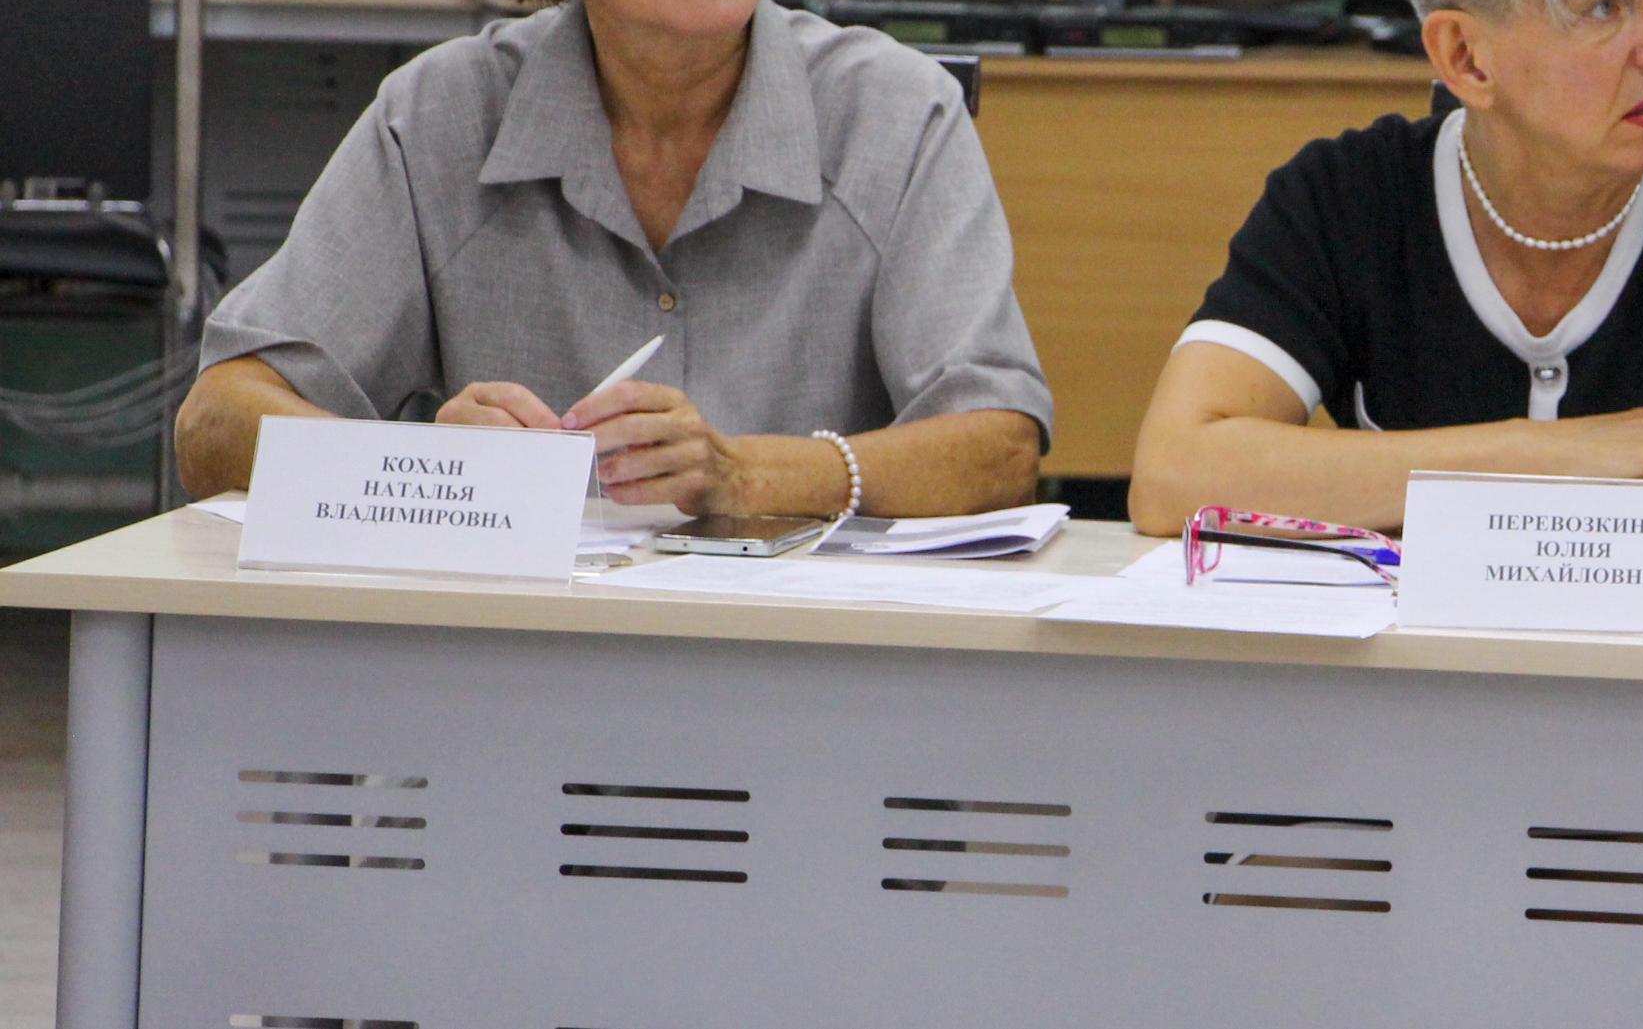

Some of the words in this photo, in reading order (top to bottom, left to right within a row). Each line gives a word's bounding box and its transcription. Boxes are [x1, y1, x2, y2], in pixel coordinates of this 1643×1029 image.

[381, 456, 464, 476] КОХАН
[363, 480, 474, 502] НАТАЛЬЯ
[315, 502, 512, 530] ВЛАДИМИРОВНА
[1536, 540, 1611, 559] ЮЛИЯ
